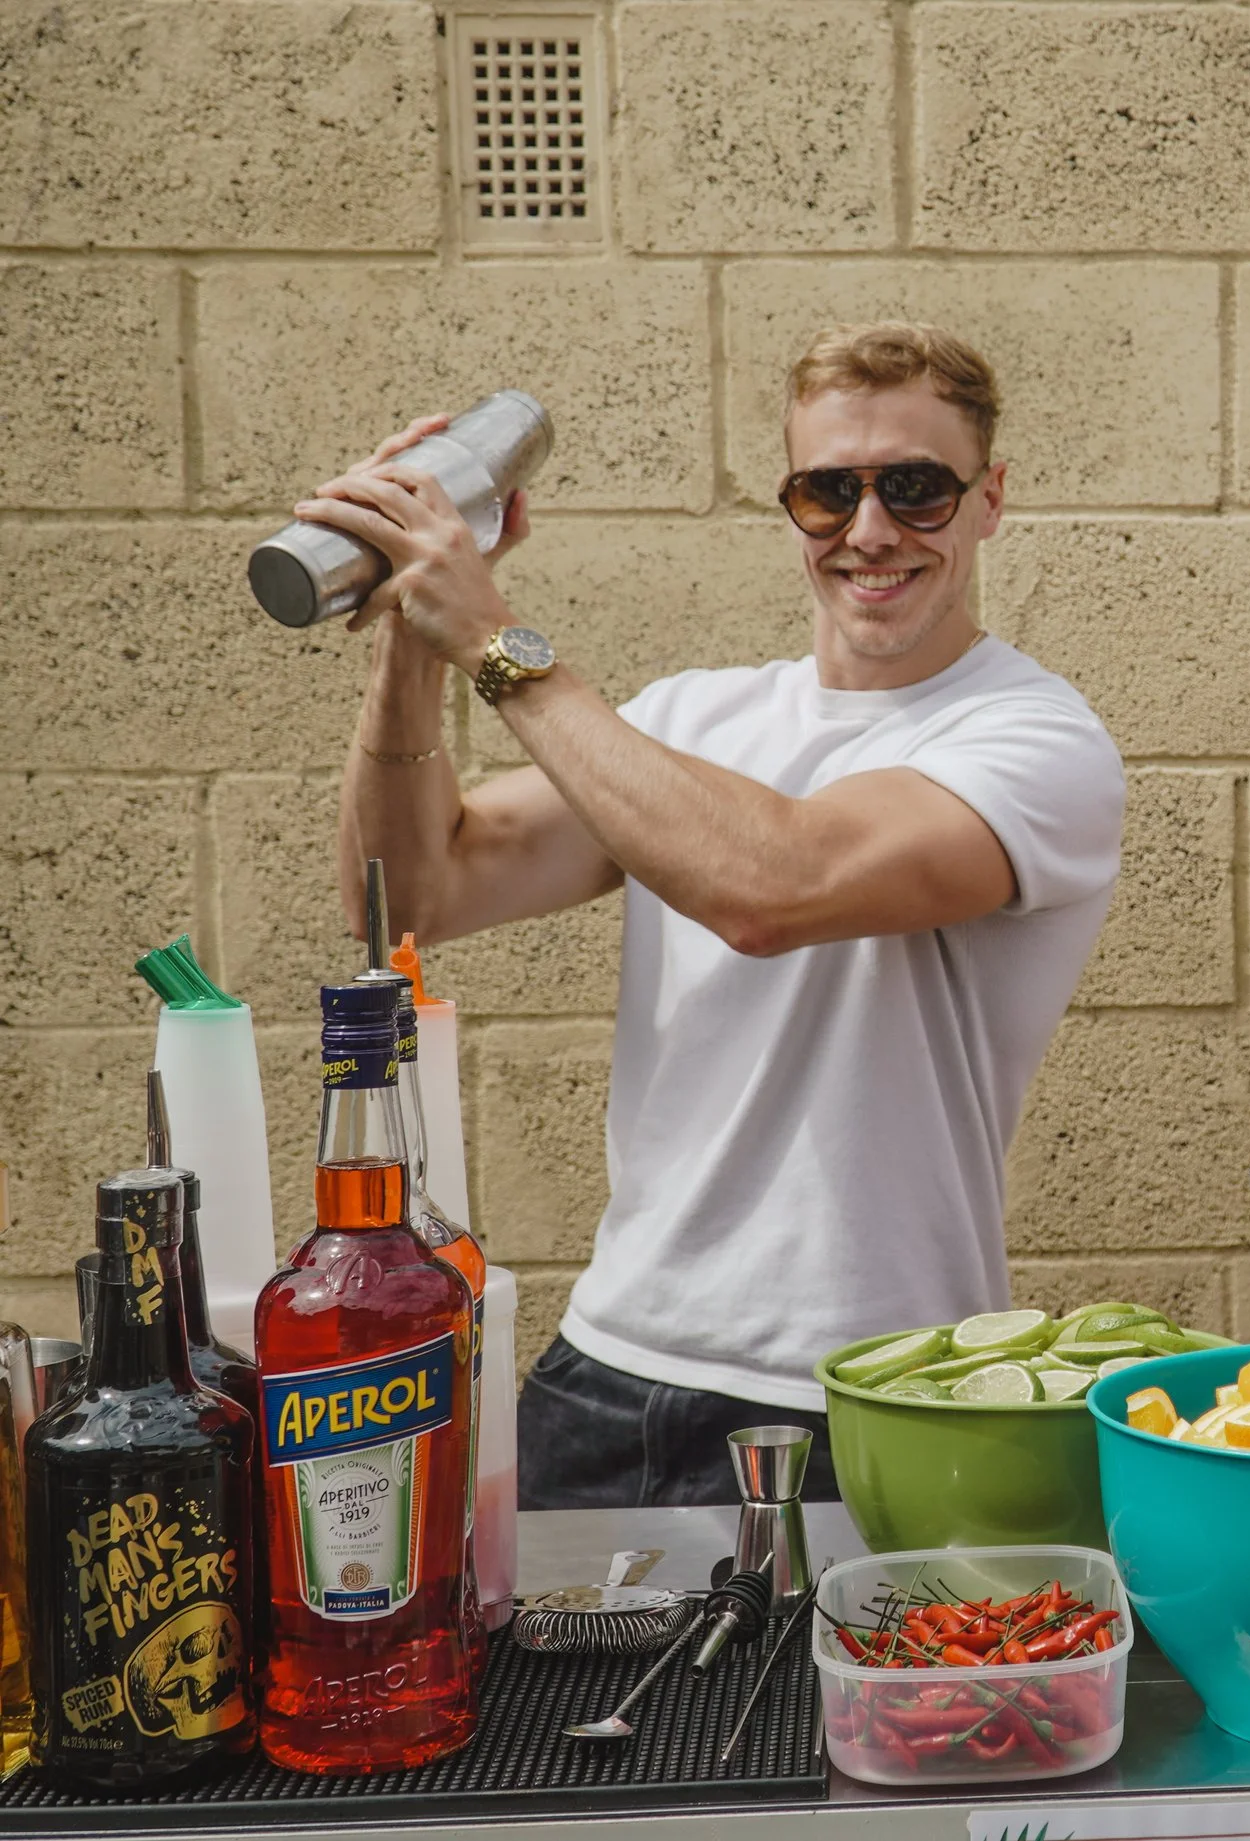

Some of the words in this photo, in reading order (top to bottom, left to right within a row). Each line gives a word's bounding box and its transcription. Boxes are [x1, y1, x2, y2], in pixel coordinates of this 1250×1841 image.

[123, 1217, 164, 1325] DMF
[278, 1369, 436, 1447] APEROL
[321, 1463, 345, 1480] RICETTA
[347, 1460, 383, 1477] ORIGINALE
[318, 1478, 389, 1506] APERITIVO
[344, 1501, 363, 1510] DAL
[340, 1506, 370, 1524] 1919
[67, 1493, 158, 1568] DEAD
[349, 1523, 381, 1540] BARBIERI
[79, 1522, 184, 1605] MAN'S
[83, 1549, 237, 1646] FINGERS
[66, 1680, 116, 1711] SPICED
[80, 1700, 113, 1724] RUM
